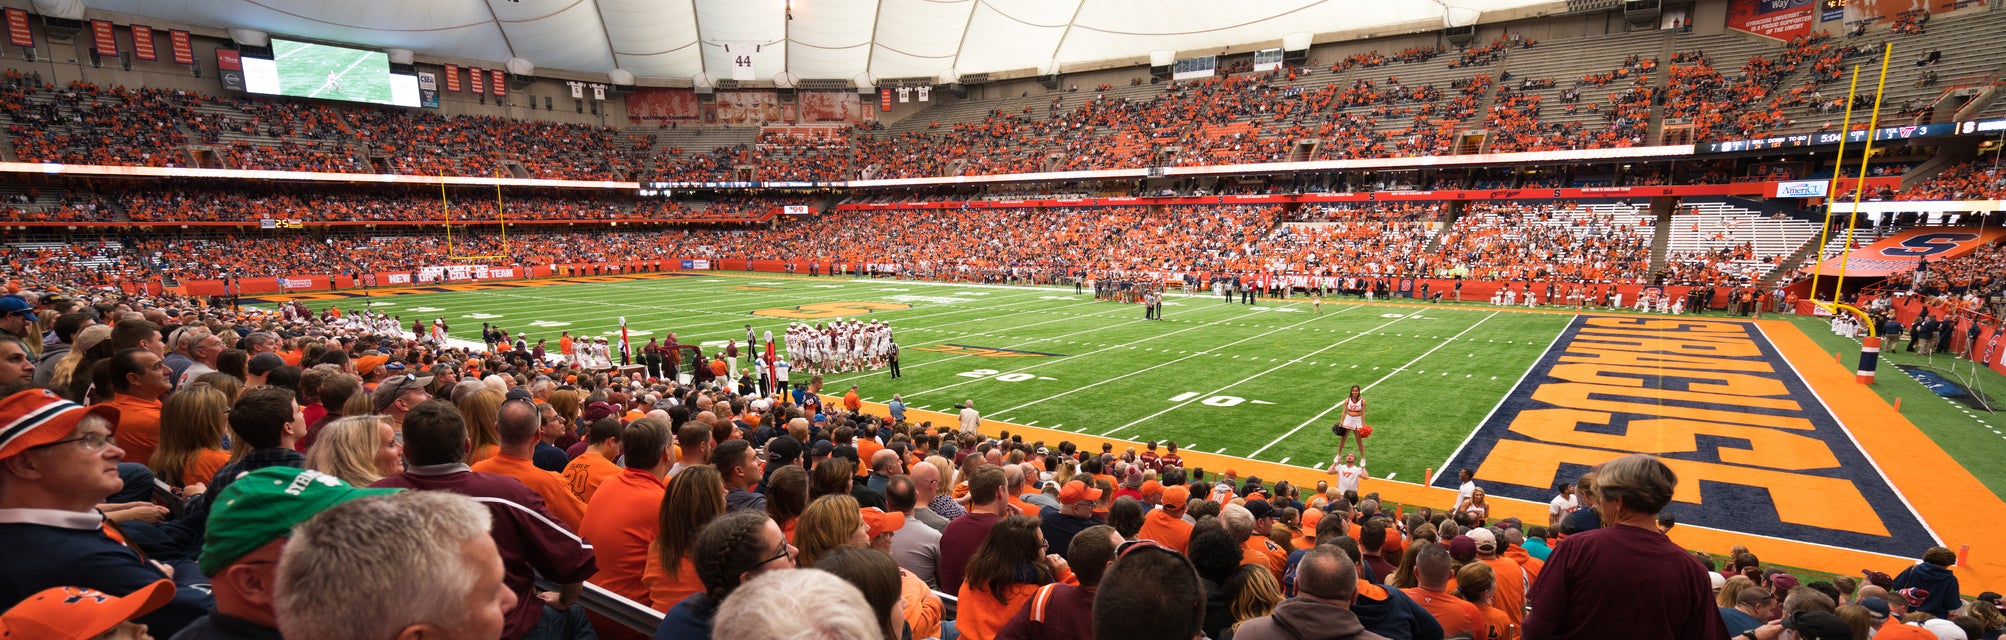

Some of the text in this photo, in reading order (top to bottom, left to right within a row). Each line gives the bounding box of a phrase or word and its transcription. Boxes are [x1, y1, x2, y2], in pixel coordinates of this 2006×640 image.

[1771, 0, 1789, 9] Way
[735, 55, 751, 67] 44
[1919, 127, 1927, 135] 3
[1821, 133, 1842, 143] 5:04
[1553, 189, 1561, 198] S
[276, 219, 289, 228] 25
[388, 274, 410, 284] NEW
[449, 270, 489, 280] COLLGE
[489, 269, 514, 278] TEAM
[1400, 280, 1412, 292] S
[956, 368, 1036, 382] 20
[1167, 391, 1247, 407] 10
[1474, 315, 1893, 537] SYRACUSE
